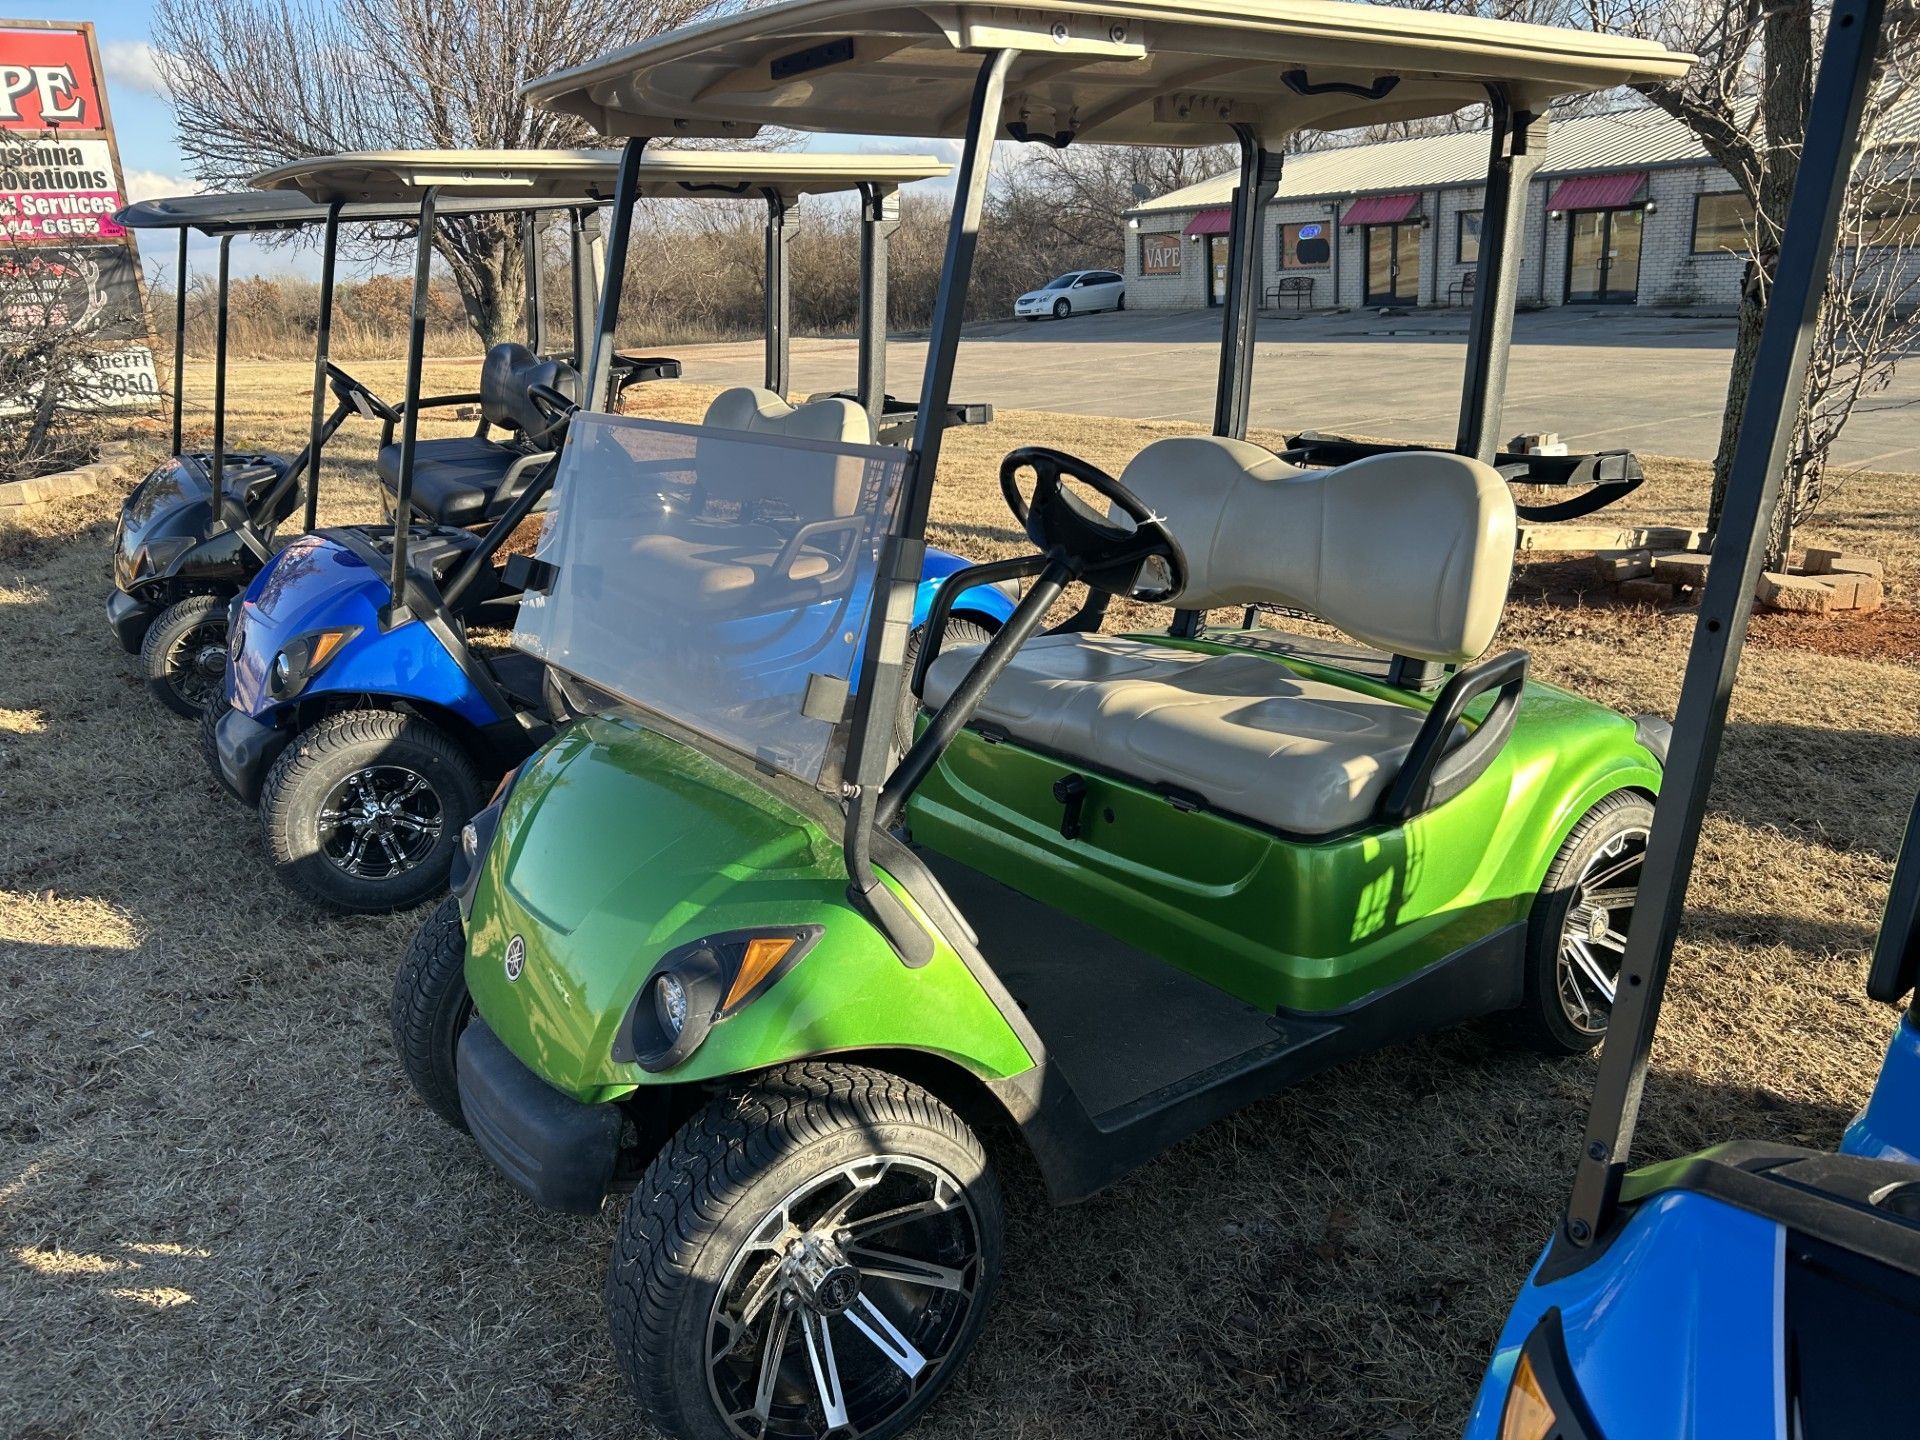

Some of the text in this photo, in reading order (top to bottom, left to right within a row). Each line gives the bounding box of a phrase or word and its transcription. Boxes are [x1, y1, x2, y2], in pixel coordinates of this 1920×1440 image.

[0, 167, 107, 190] ovations
[21, 194, 117, 215] Services
[1146, 247, 1181, 268] VAPE
